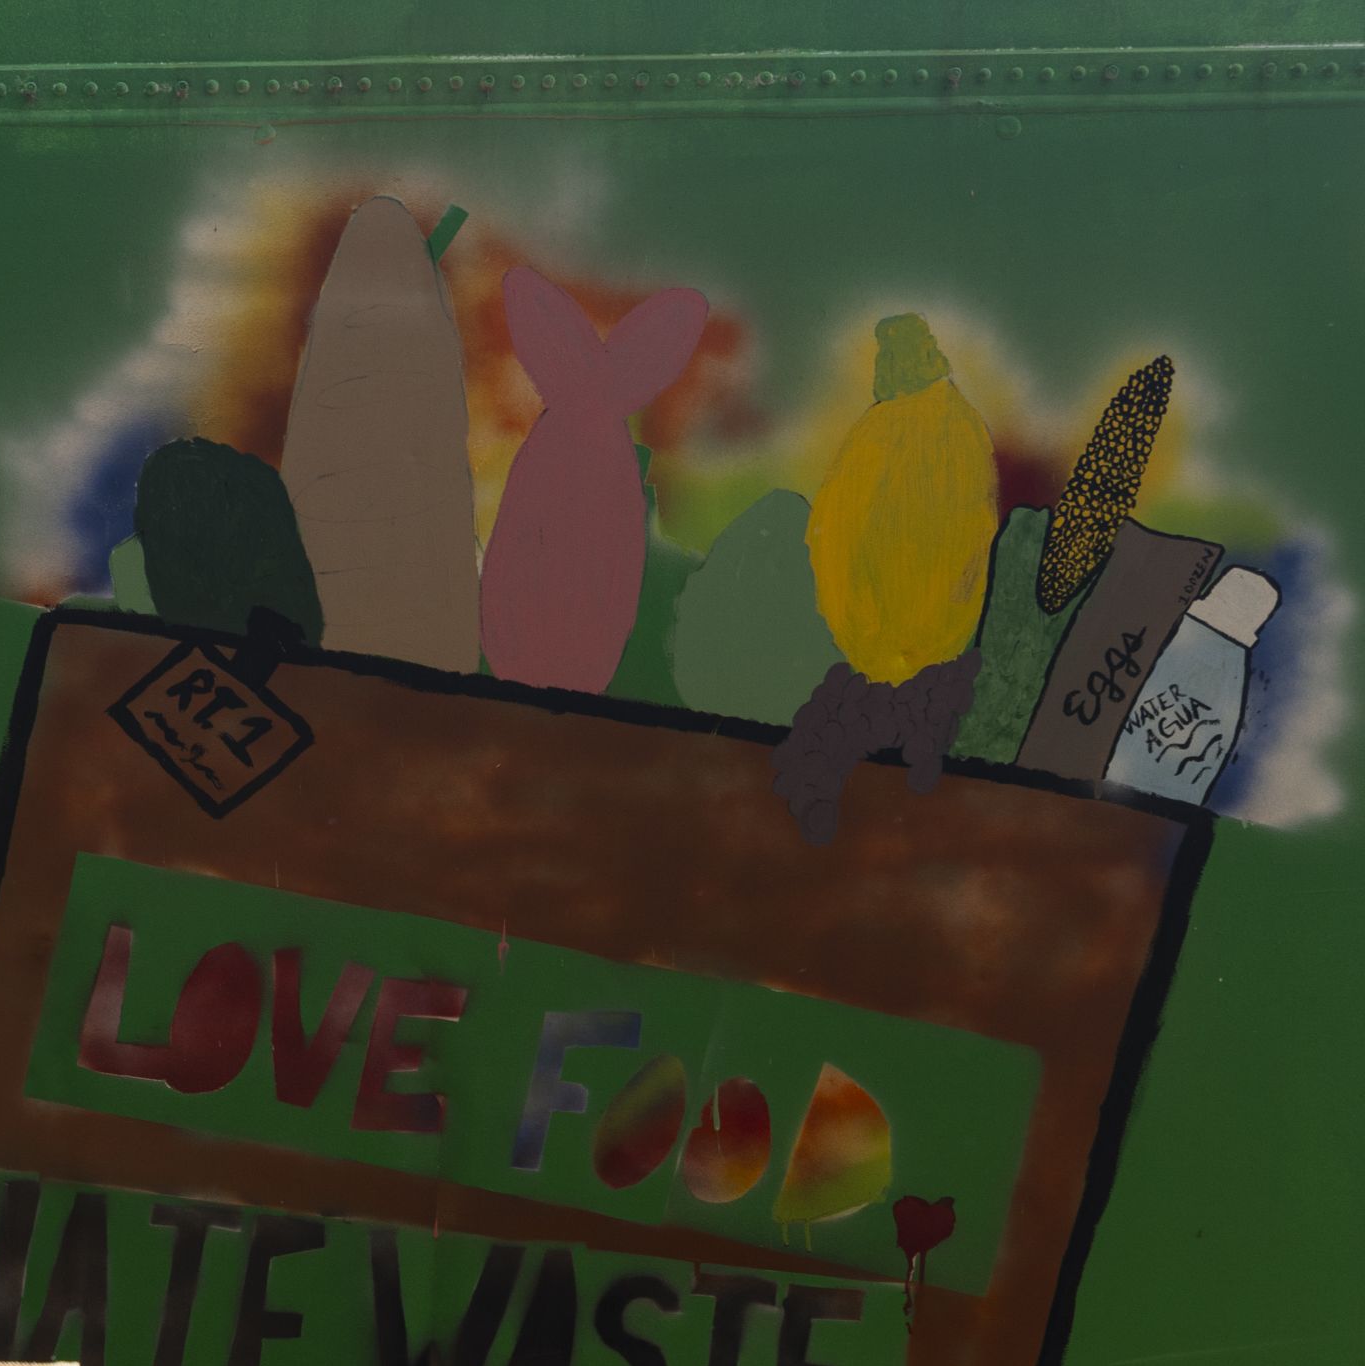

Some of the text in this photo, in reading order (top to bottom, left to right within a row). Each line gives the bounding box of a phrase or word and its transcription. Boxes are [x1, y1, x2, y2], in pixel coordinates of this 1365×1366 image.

[1123, 684, 1186, 735] WATER
[1146, 698, 1211, 753] AGUA
[77, 925, 891, 1225] LOVE FOOD
